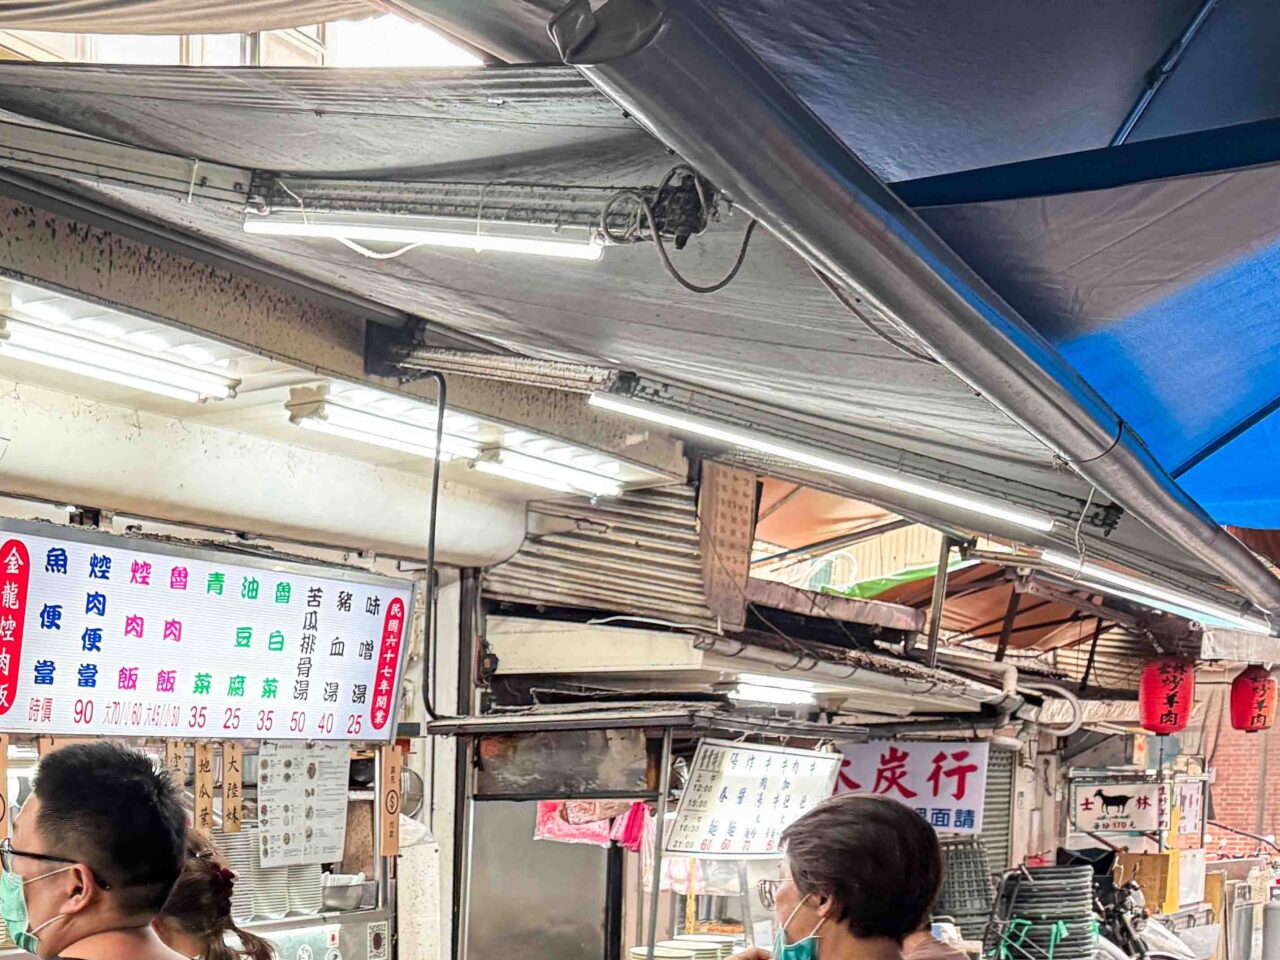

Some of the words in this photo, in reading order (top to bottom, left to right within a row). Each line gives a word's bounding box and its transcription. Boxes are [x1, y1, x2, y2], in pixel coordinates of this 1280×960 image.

[34, 547, 68, 686] 魚便當
[78, 553, 112, 688] 焢肉便當
[118, 559, 152, 690] 焢肉飯
[156, 566, 188, 692] 魯肉飯
[192, 572, 226, 695] 青菜
[227, 576, 260, 697] 油豆腐
[261, 581, 291, 700] 魯白菜
[293, 587, 323, 701] 苦瓜排骨湯
[351, 595, 381, 704] 味噌湯
[28, 697, 54, 722] 時價
[73, 699, 94, 724] 90
[188, 706, 208, 728] 35
[223, 708, 241, 730] 25
[257, 710, 274, 732] 35
[290, 711, 306, 732] 50
[318, 712, 334, 734] 40
[347, 714, 362, 734] 25
[198, 757, 211, 826] 地瓜葉
[226, 756, 240, 824] 大陸妹
